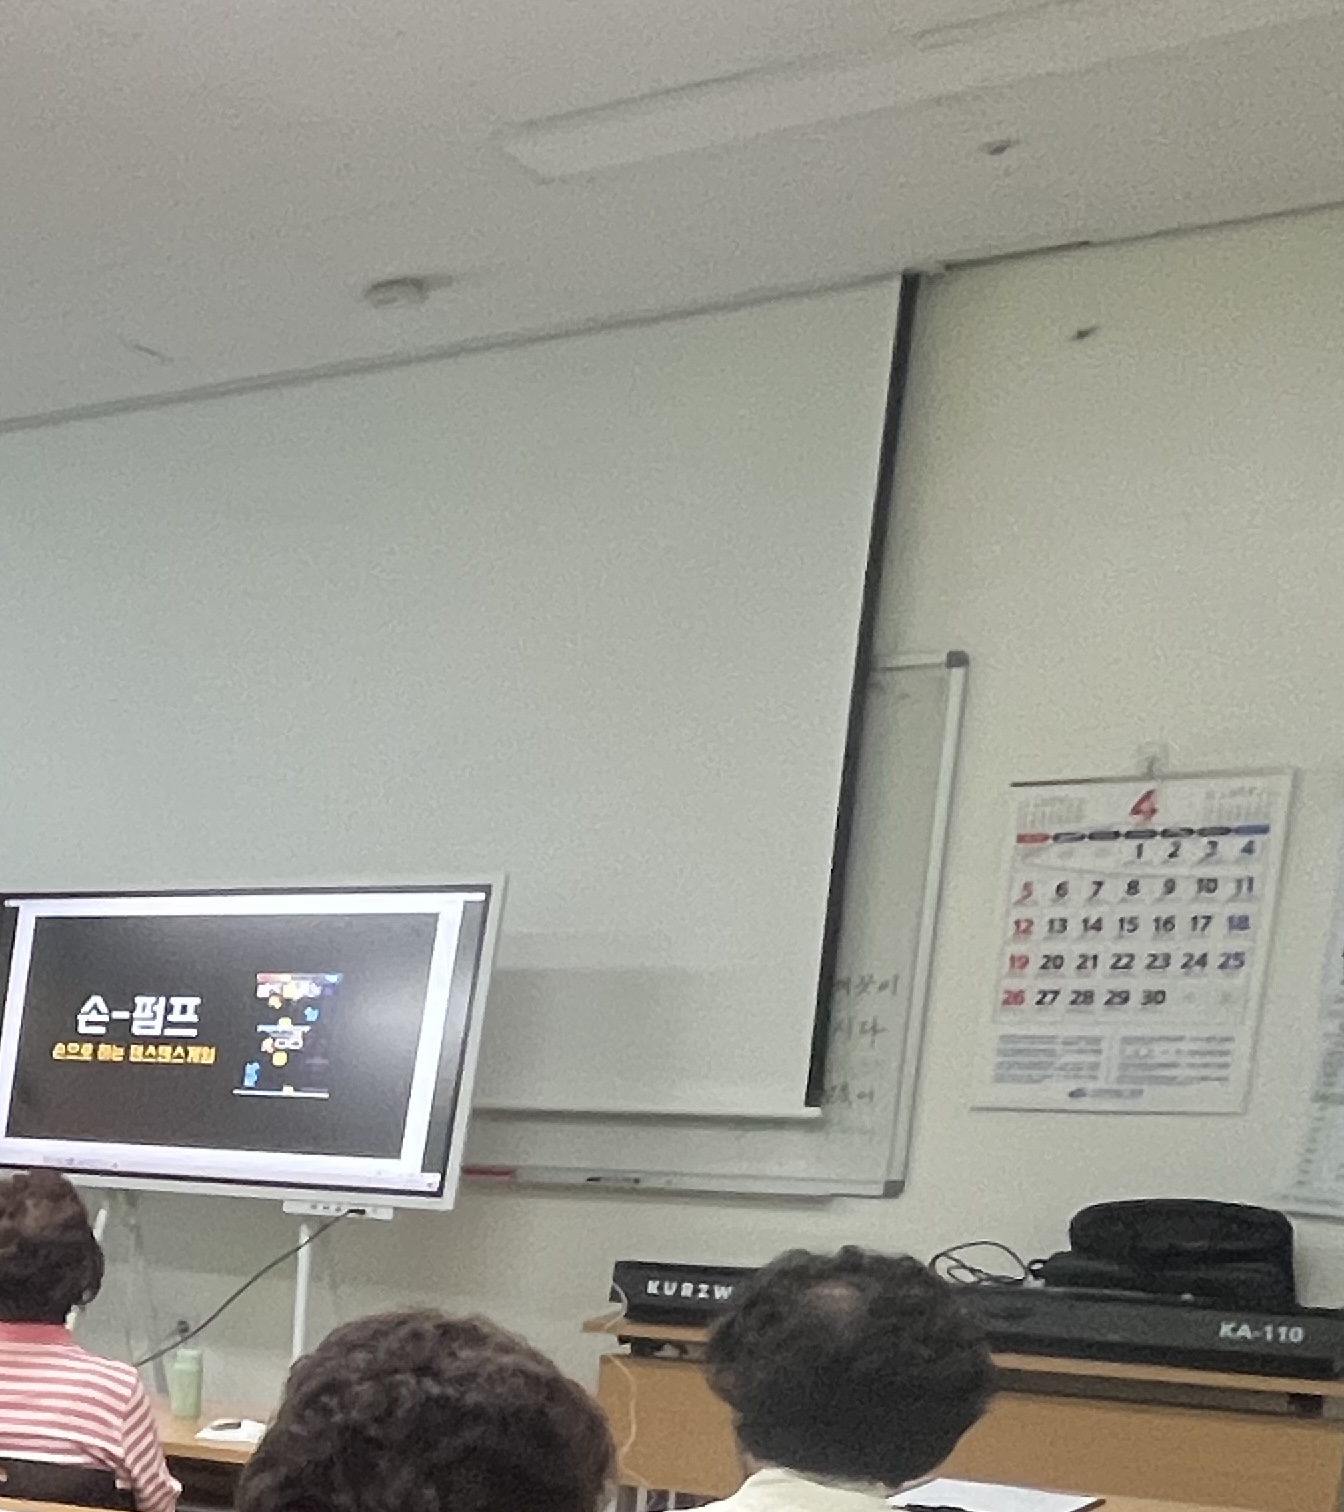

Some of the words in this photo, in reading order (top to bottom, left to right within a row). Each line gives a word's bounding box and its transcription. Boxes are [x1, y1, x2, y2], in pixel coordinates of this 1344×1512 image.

[1128, 788, 1159, 823] 4
[1135, 842, 1144, 859] 1
[1166, 840, 1182, 859] 2
[1206, 839, 1220, 858] 3
[1240, 840, 1256, 856] 4
[1021, 880, 1034, 899] 5
[1054, 880, 1069, 898] 6
[1091, 880, 1106, 898] 7
[1125, 879, 1140, 896] 8
[1162, 878, 1176, 896] 9
[1196, 877, 1218, 895] 10
[1234, 876, 1255, 896] 11
[1014, 918, 1034, 934] 12
[1047, 917, 1068, 934] 13
[1082, 916, 1103, 933] 14
[1118, 916, 1140, 933] 15
[1153, 914, 1176, 933] 16
[1189, 914, 1213, 932] 17
[1227, 914, 1252, 932] 18
[1009, 953, 1030, 971] 19
[1038, 954, 1064, 971] 20
[1075, 953, 1099, 971] 21
[1109, 952, 1136, 970] 22
[1144, 952, 1172, 970] 23
[1180, 951, 1208, 970] 24
[1217, 951, 1246, 970] 25
[1001, 989, 1026, 1006] 26
[1034, 988, 1061, 1006] 27
[1068, 989, 1095, 1006] 28
[1103, 989, 1131, 1006] 29
[1140, 989, 1167, 1006] 30
[75, 993, 203, 1039] 손-펌프
[1218, 1320, 1305, 1344] KA-110
